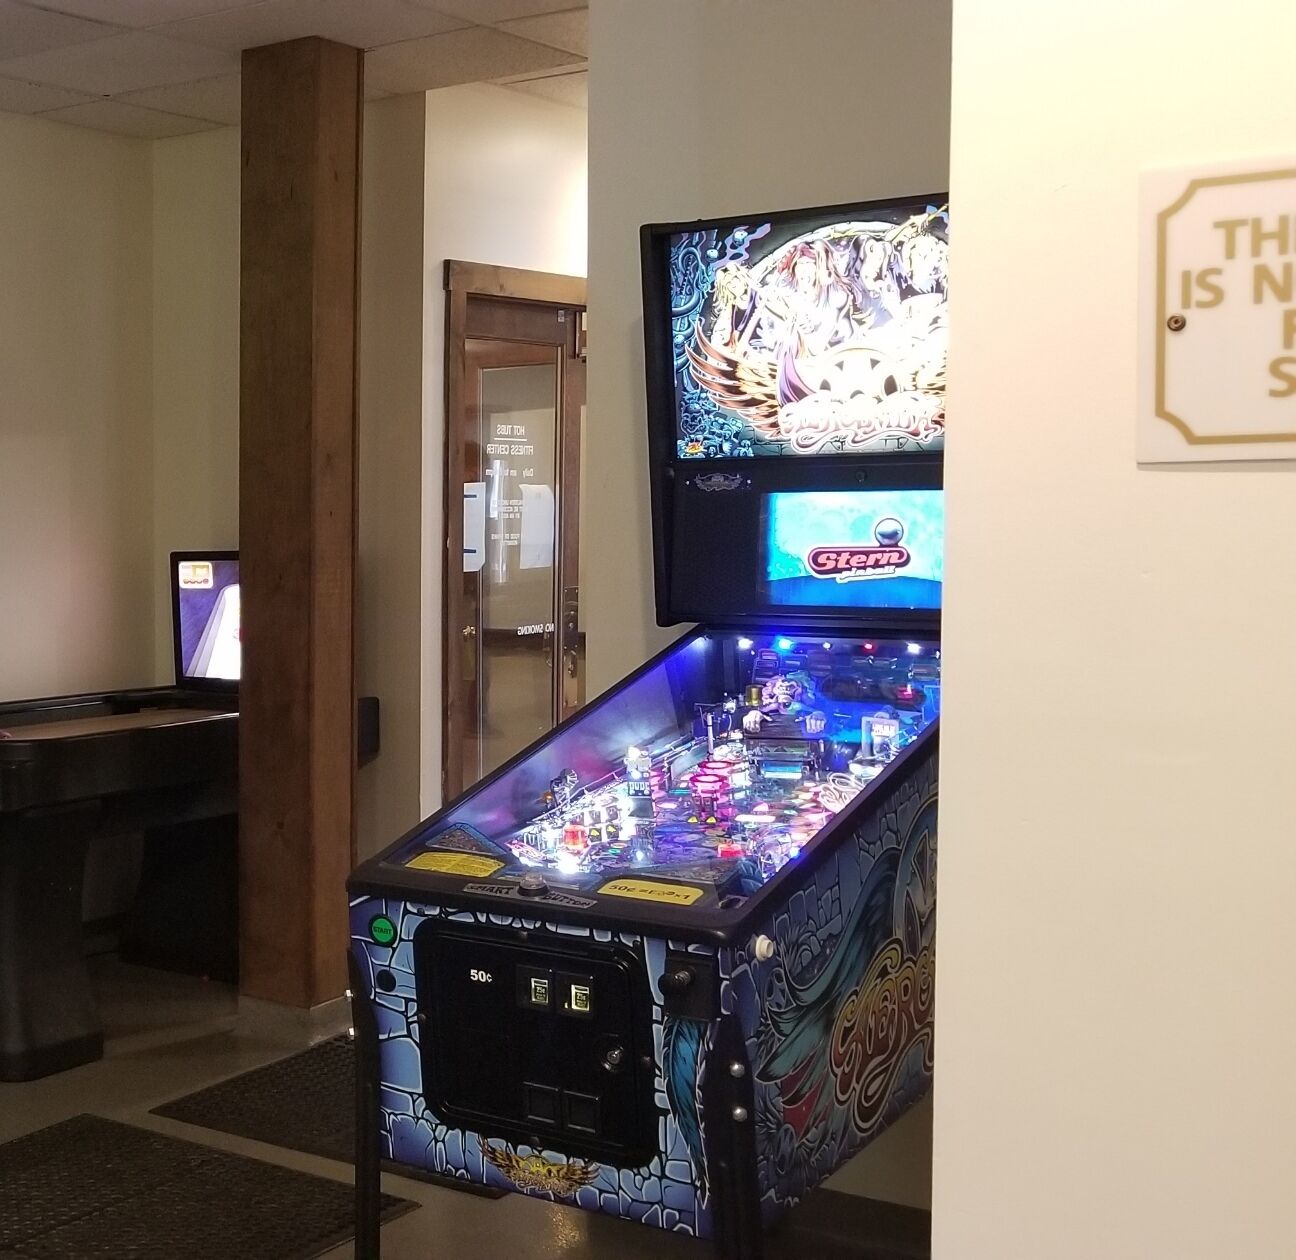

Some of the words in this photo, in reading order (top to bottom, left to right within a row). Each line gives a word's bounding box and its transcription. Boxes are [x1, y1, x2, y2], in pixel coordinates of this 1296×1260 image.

[1213, 214, 1296, 260] TH
[1181, 267, 1225, 309] IS
[817, 552, 900, 571] Stern
[466, 884, 515, 896] SMART
[542, 891, 592, 907] BUTTON
[373, 926, 391, 935] START
[469, 968, 493, 983] 50¢
